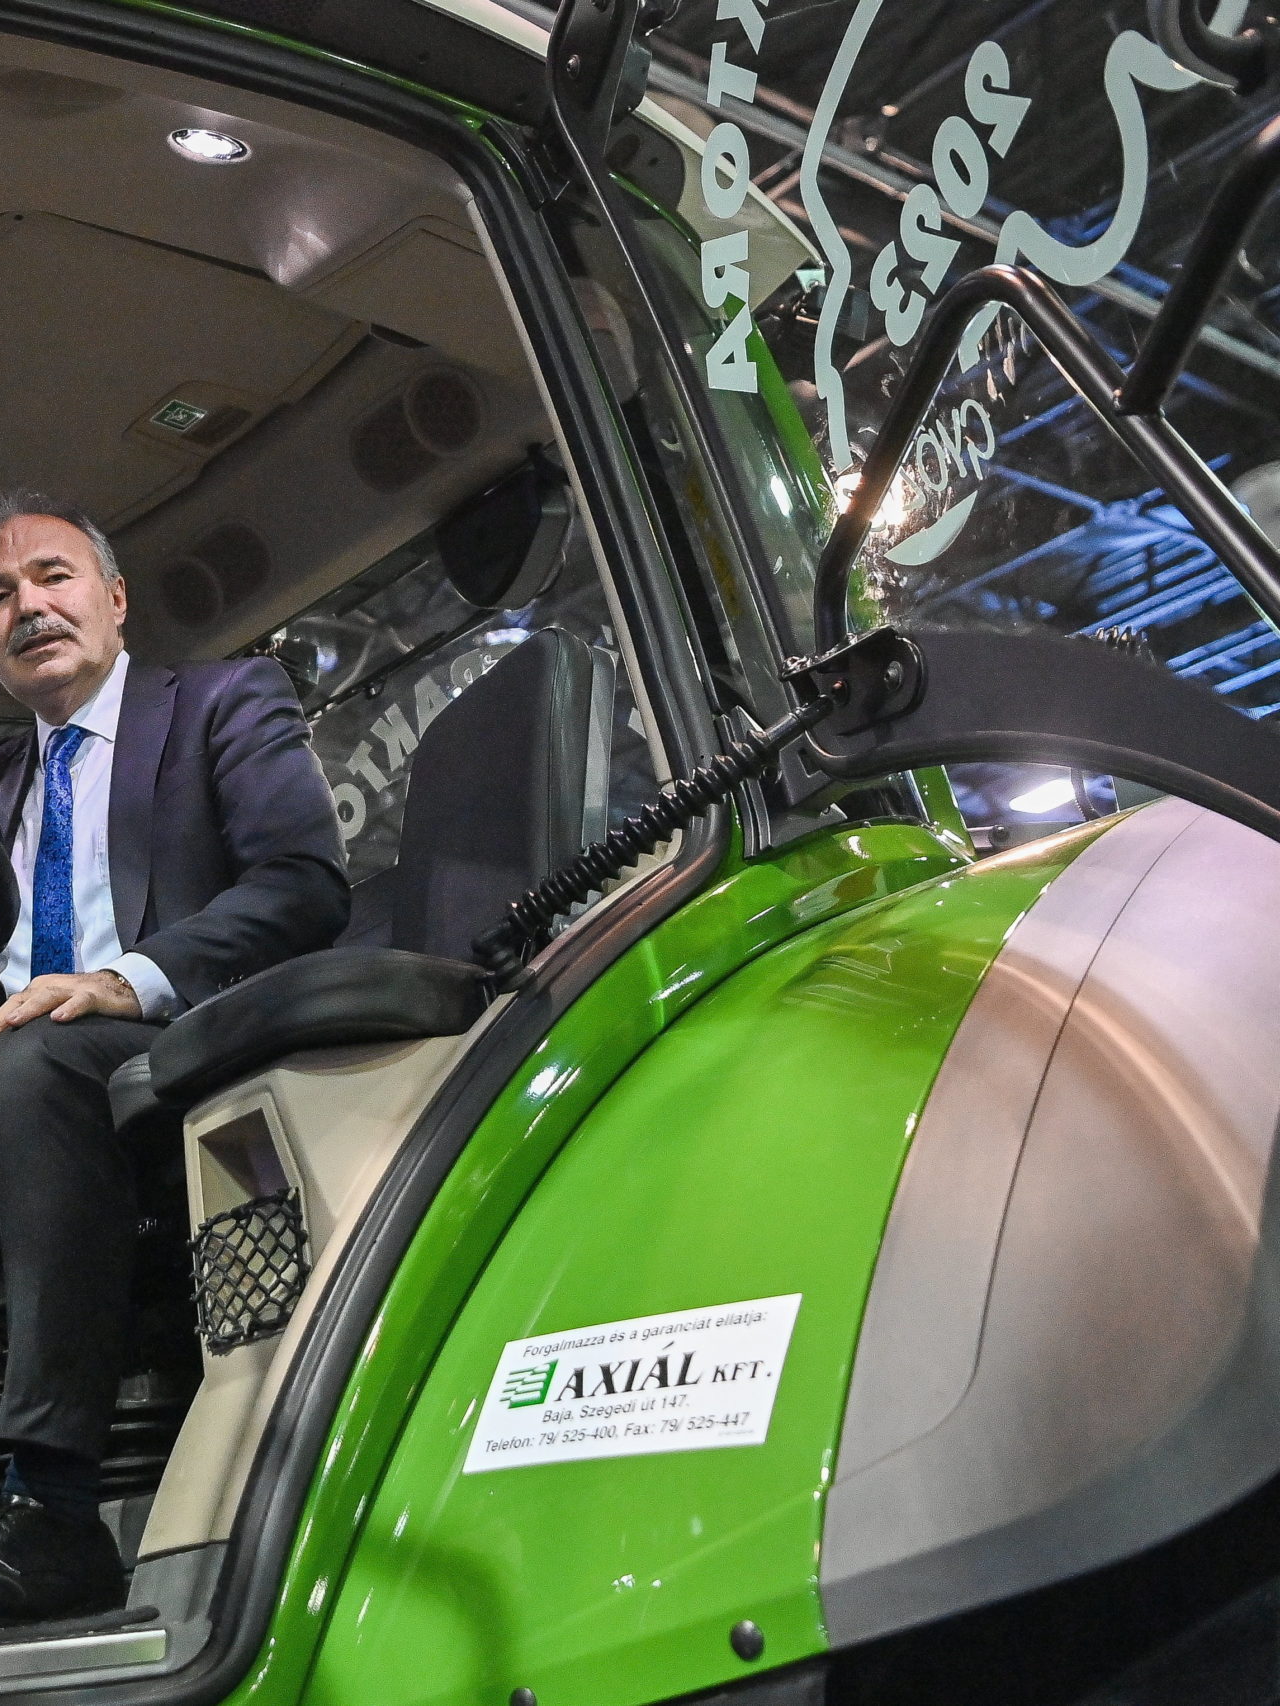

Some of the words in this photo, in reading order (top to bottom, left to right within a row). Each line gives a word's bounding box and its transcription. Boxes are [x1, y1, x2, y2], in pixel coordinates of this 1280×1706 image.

[522, 1333, 606, 1358] Forgalmazza
[629, 1329, 638, 1340] a
[553, 1340, 704, 1402] AXIÁL
[711, 1360, 772, 1384] KFT.
[579, 1398, 636, 1419] Szegedi
[485, 1434, 534, 1453] Telefon:
[538, 1432, 560, 1446] 79/
[624, 1421, 656, 1437] Fax:
[687, 1411, 751, 1431] 525-447
